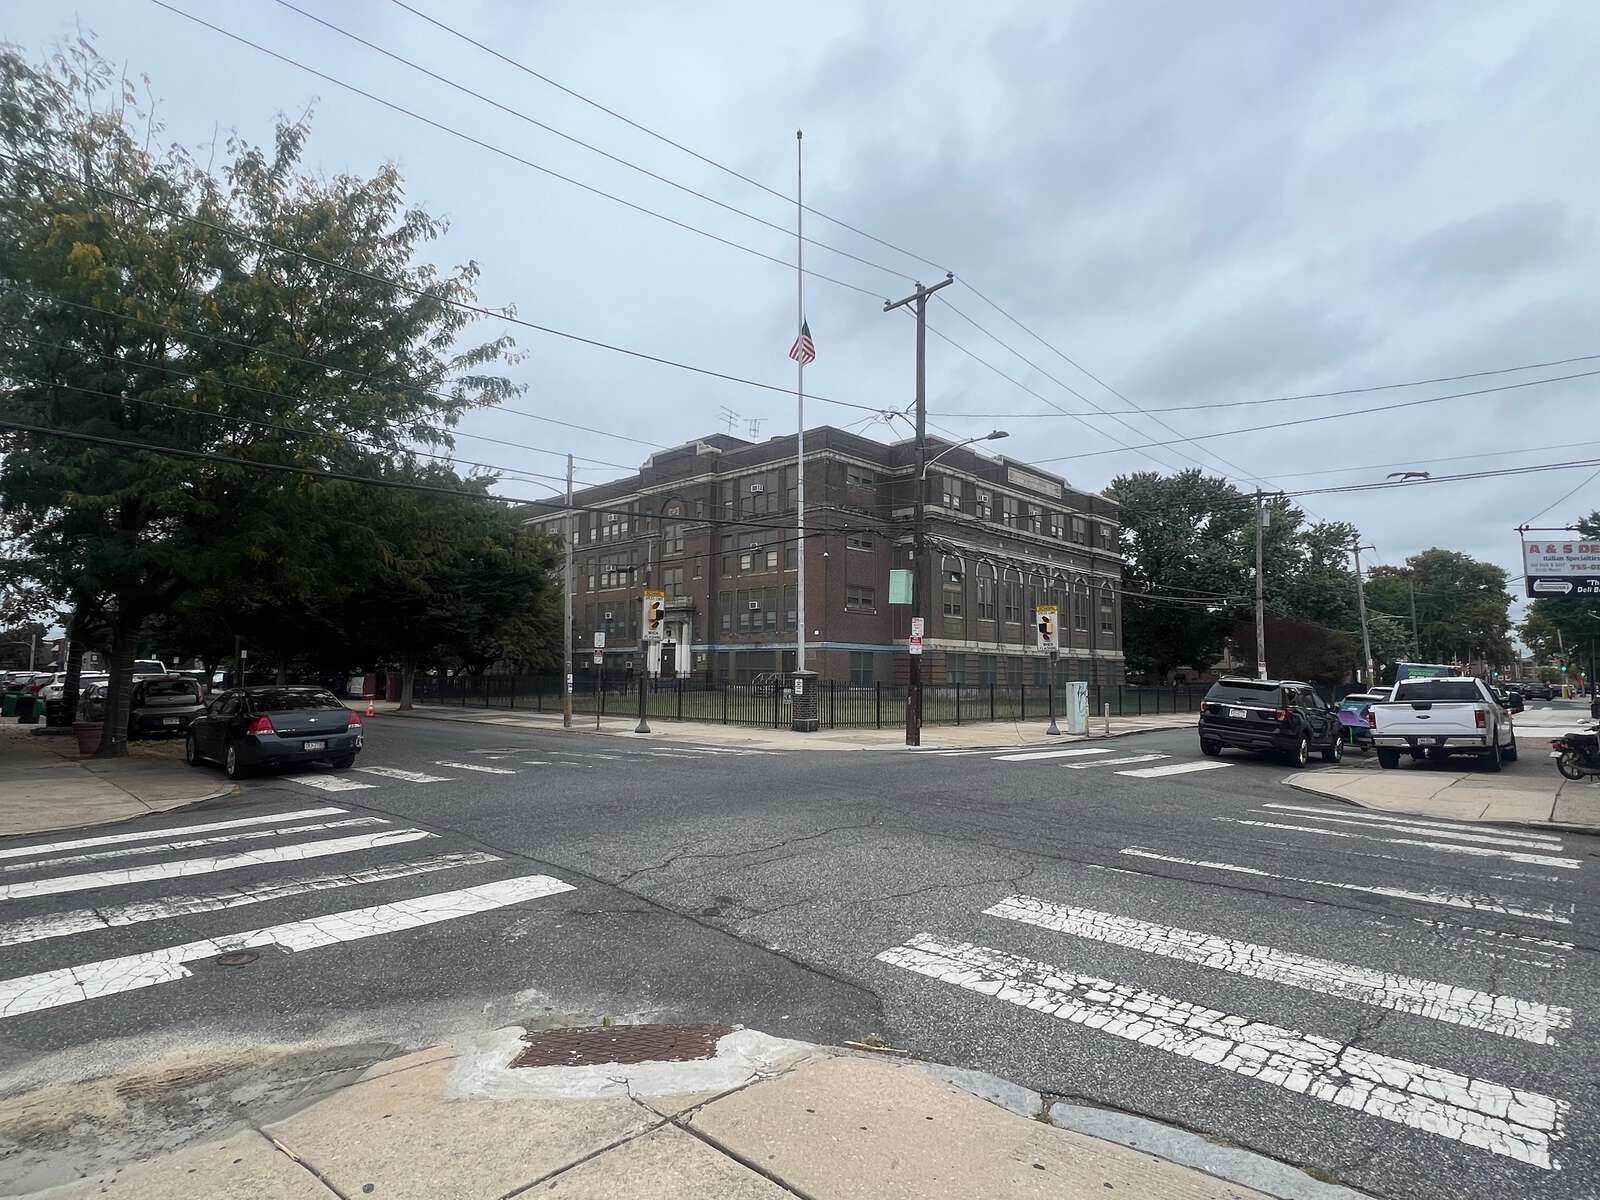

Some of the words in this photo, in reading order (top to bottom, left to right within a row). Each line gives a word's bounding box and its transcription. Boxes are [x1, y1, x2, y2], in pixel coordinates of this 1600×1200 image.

[1529, 544, 1541, 554] A
[1546, 544, 1557, 554] &
[1563, 544, 1573, 554] S
